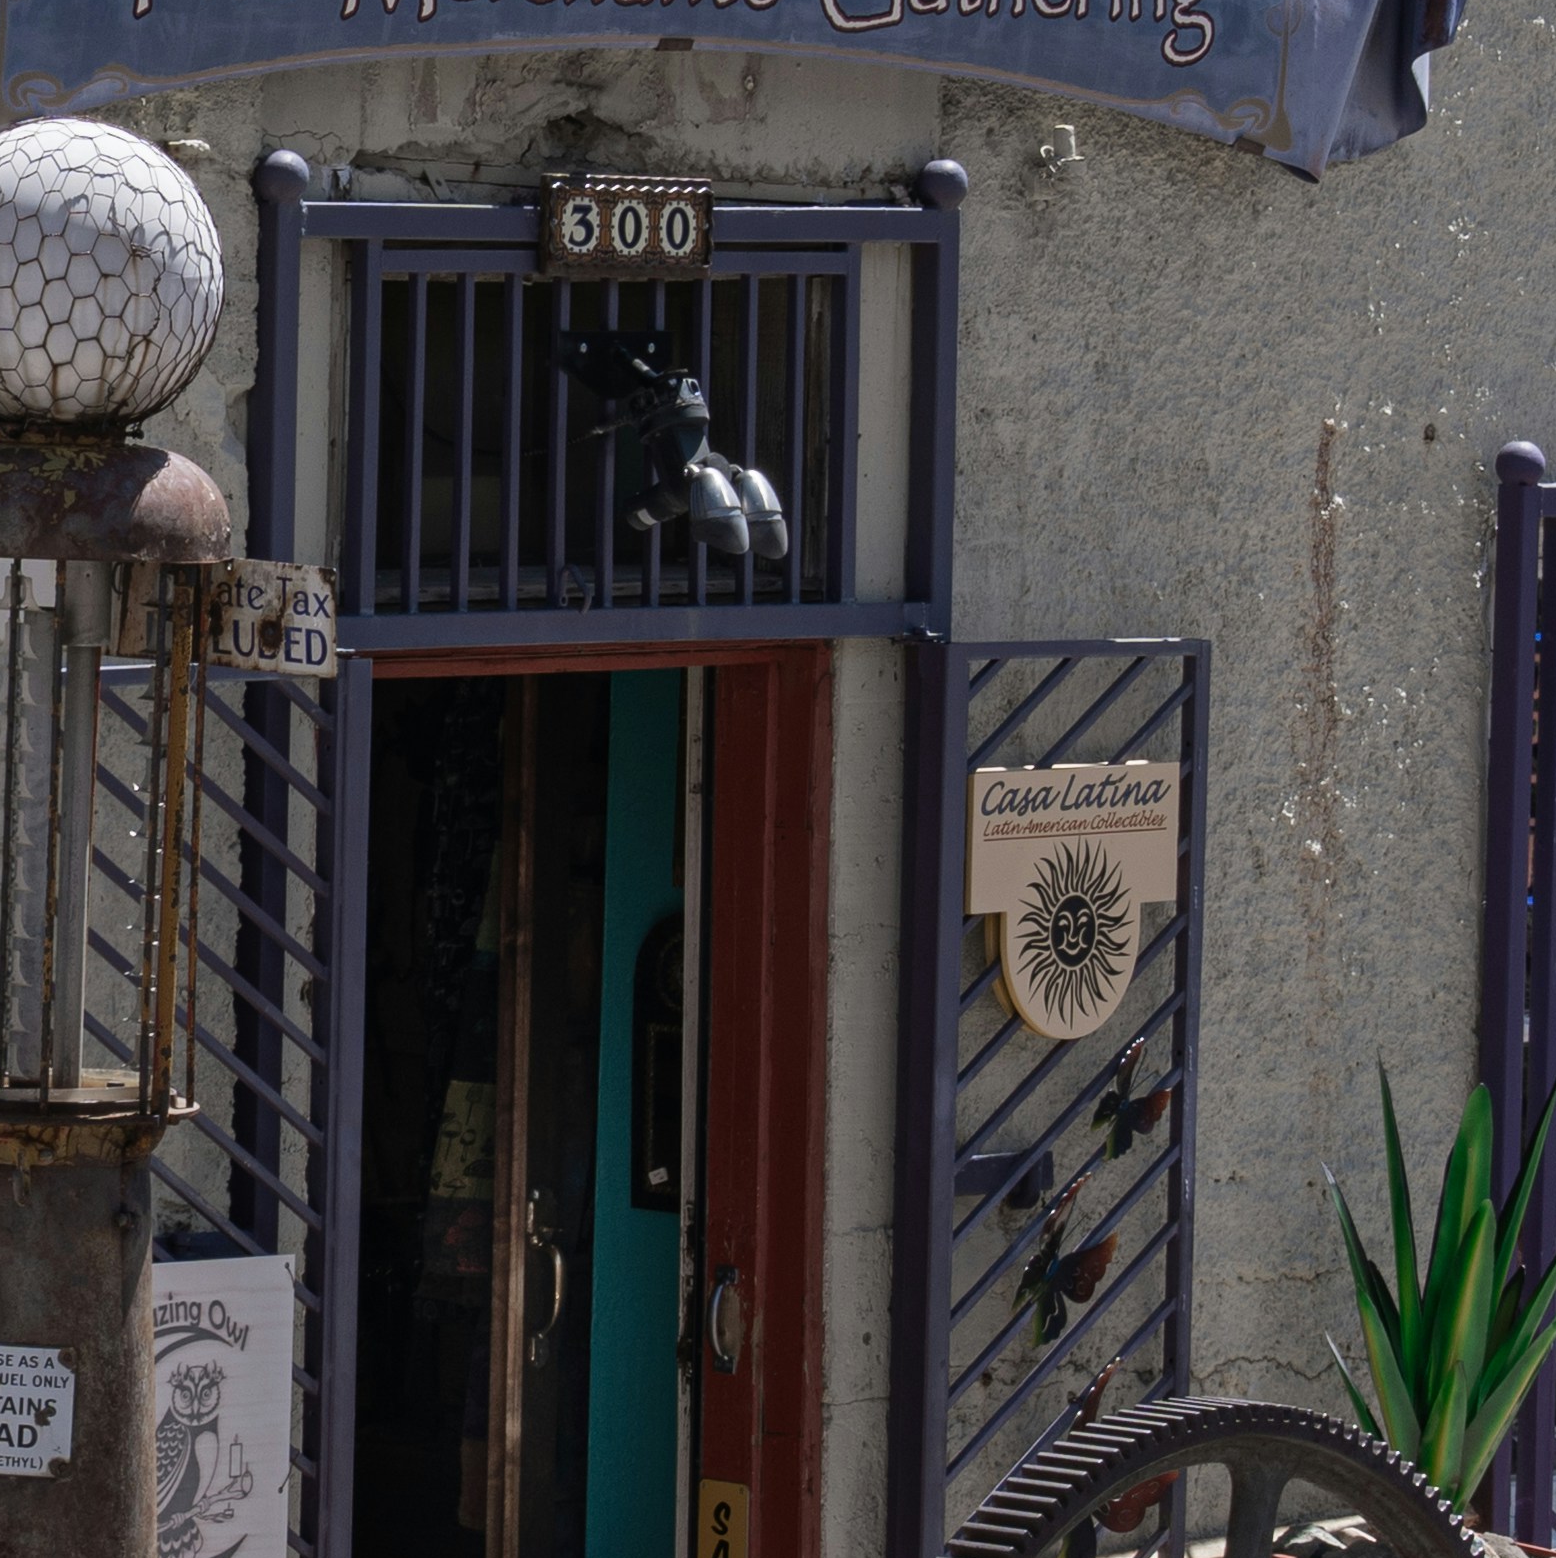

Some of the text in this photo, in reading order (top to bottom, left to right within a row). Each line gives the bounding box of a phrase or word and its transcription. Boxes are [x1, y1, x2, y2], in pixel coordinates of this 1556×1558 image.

[567, 203, 691, 251] 300
[212, 575, 331, 619] ate Tax
[981, 770, 1172, 818] Casa Latina
[983, 809, 1167, 838] Latin American Collectibles
[208, 1299, 250, 1352] Owl
[18, 1355, 39, 1369] AS
[43, 1356, 55, 1369] A
[32, 1375, 70, 1389] ONLY
